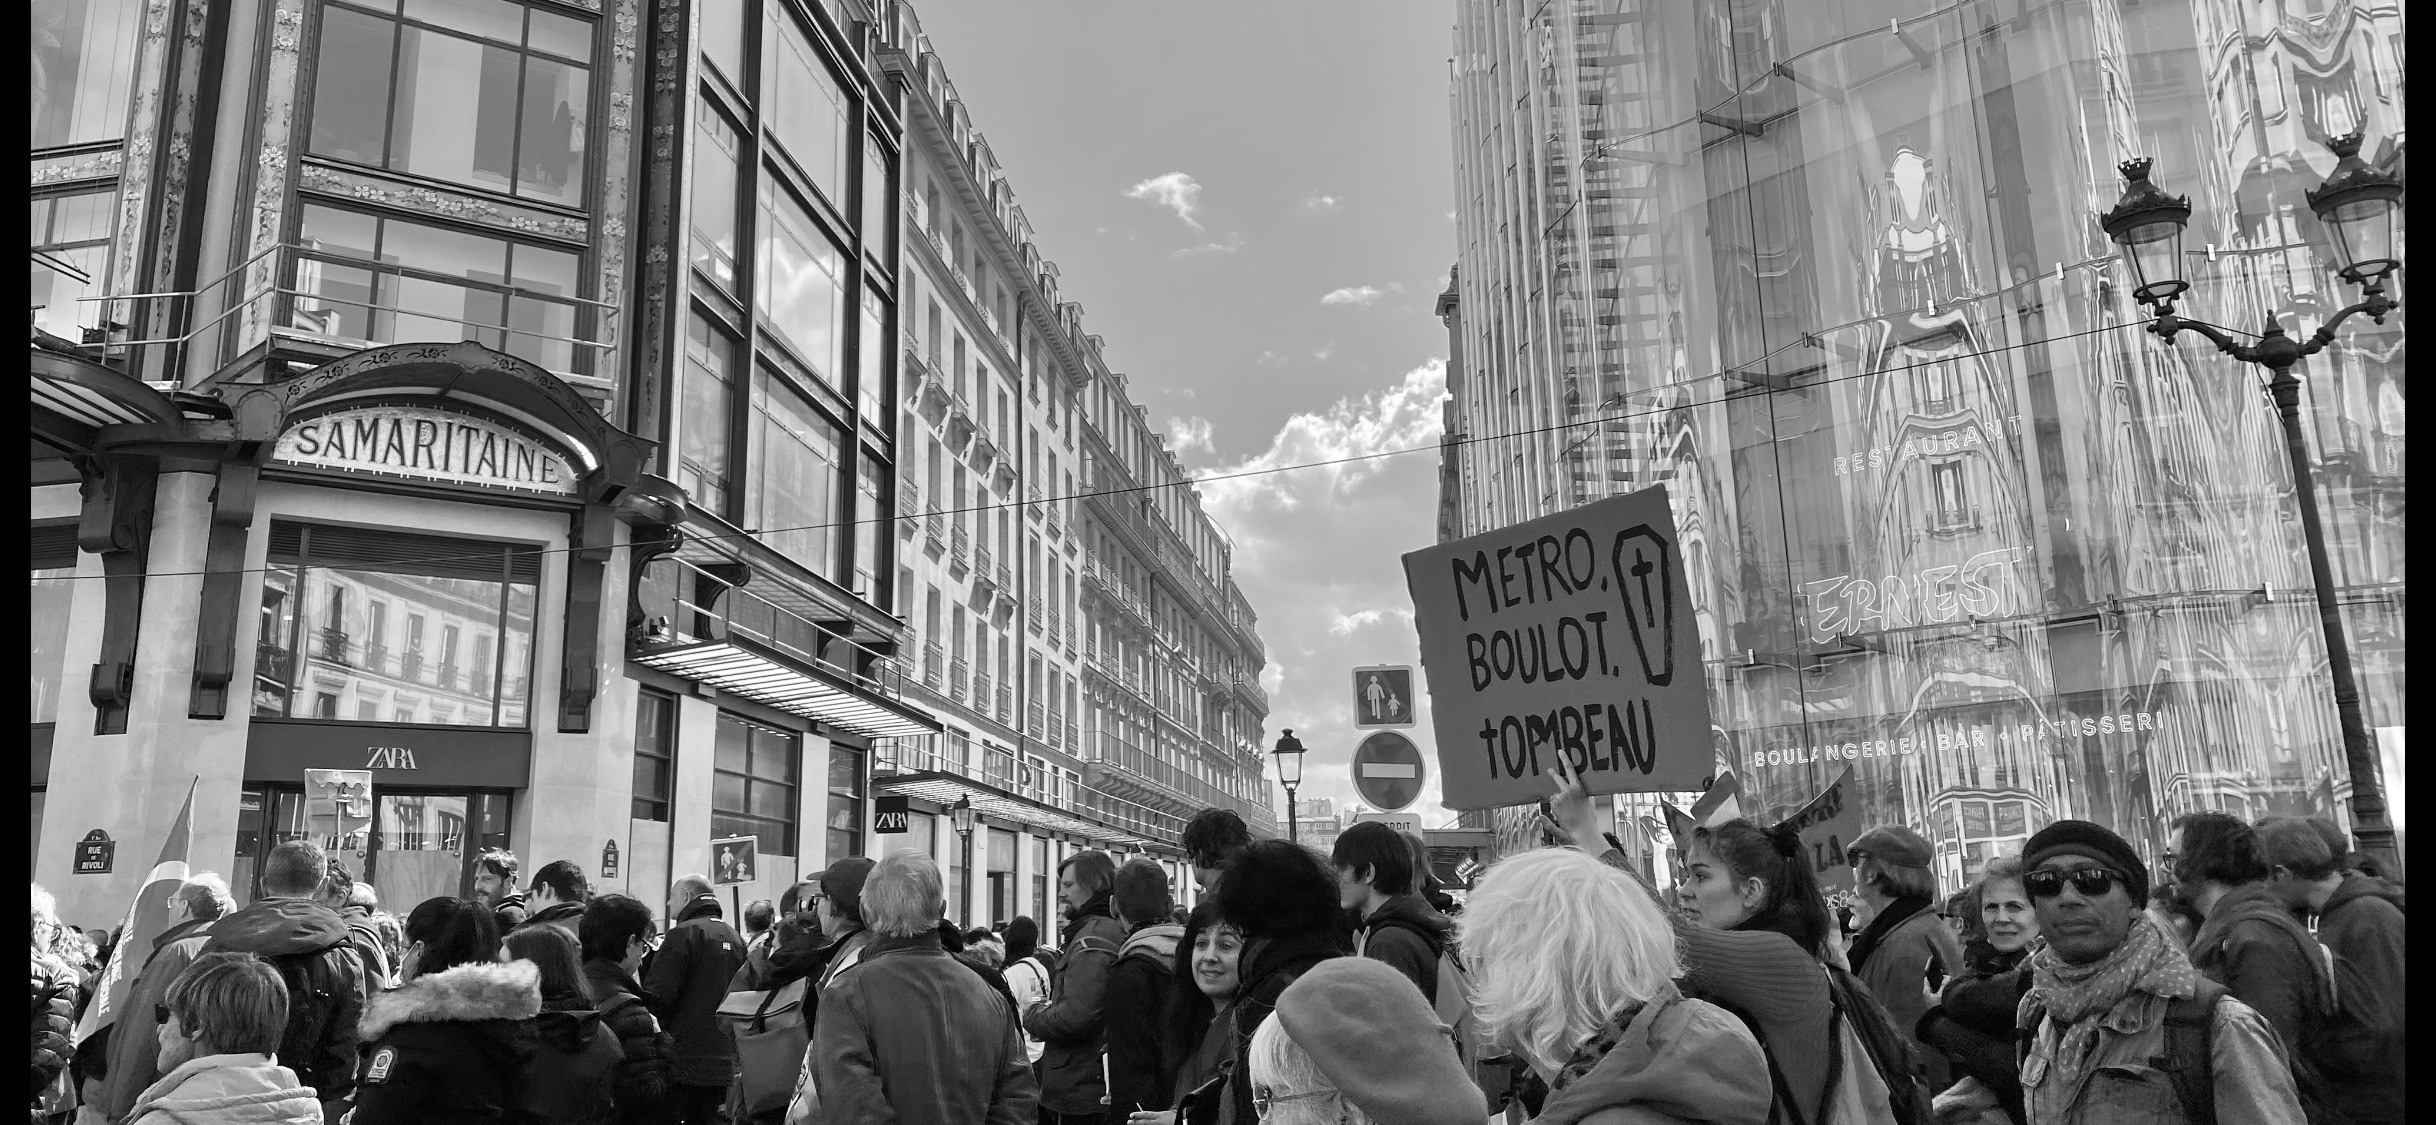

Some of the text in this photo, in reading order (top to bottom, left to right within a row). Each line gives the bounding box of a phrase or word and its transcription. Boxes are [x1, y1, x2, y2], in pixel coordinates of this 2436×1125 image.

[295, 417, 560, 484] SAMARITAINE
[1797, 546, 2034, 644] ERNEST
[1937, 731, 1985, 751] BAR
[366, 746, 418, 770] ZARA
[876, 812, 907, 829] ZARA
[88, 846, 102, 855] RUE
[81, 861, 104, 870] RIVOLI
